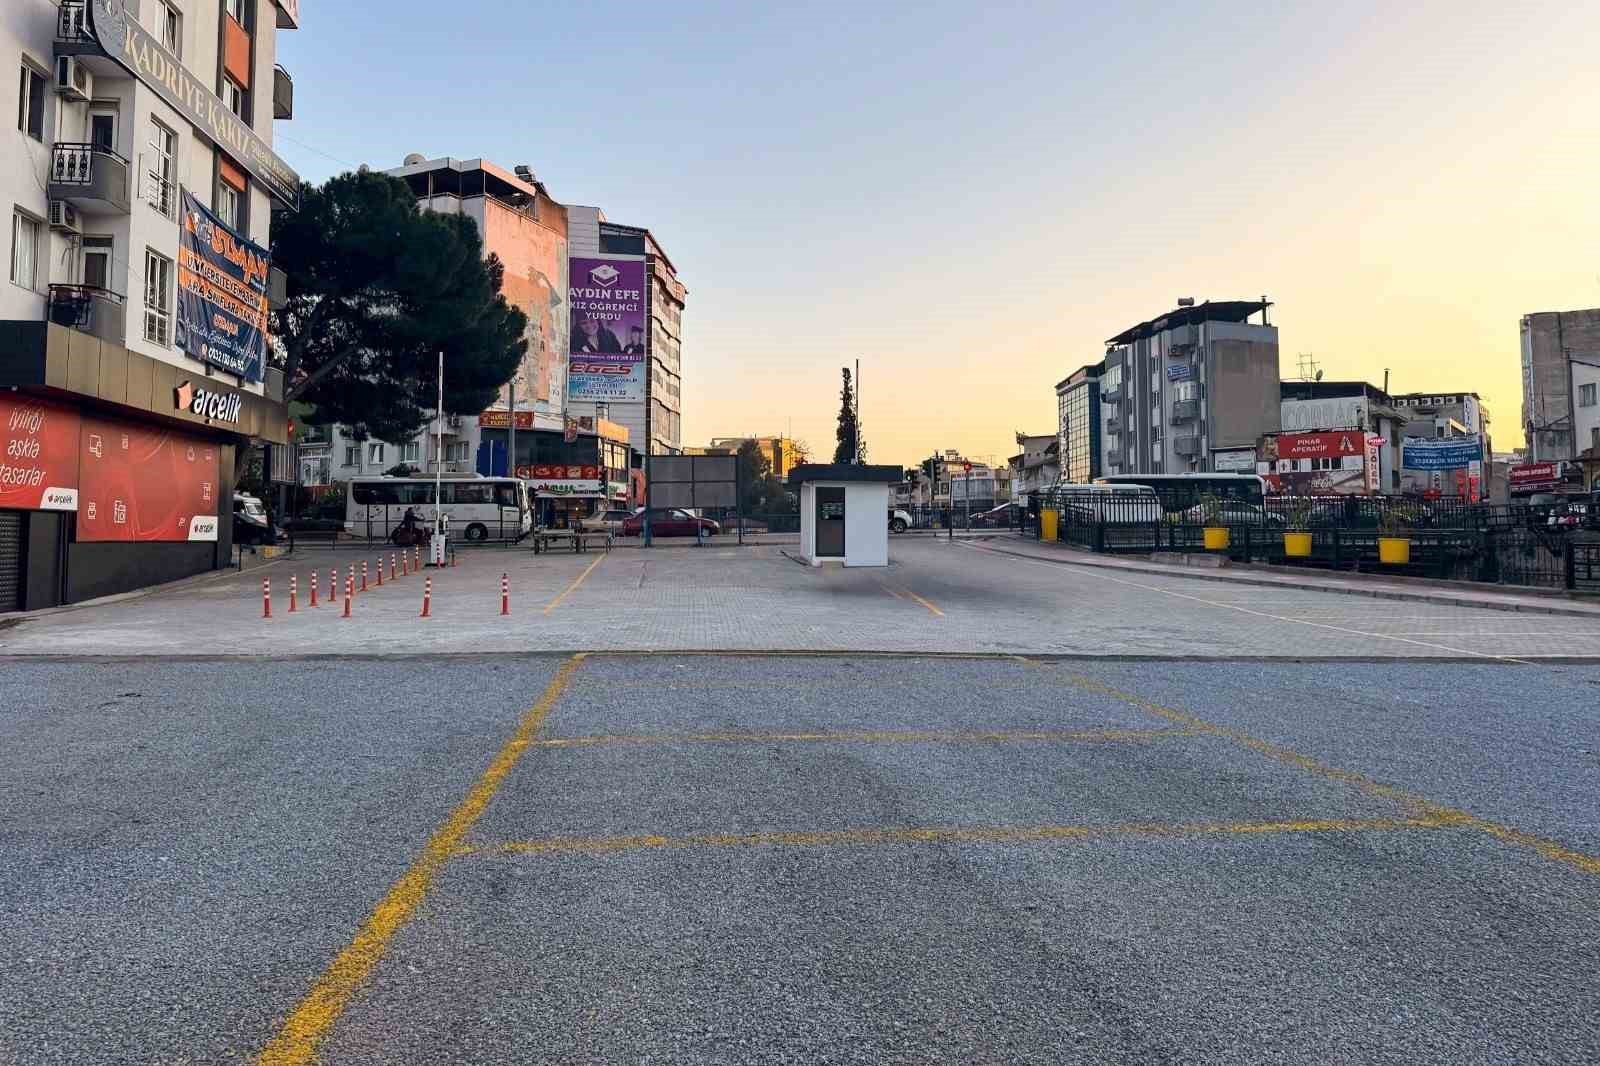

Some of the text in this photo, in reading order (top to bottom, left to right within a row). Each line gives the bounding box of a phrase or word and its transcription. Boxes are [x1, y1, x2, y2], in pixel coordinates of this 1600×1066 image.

[125, 23, 204, 118] KADRİYE
[569, 288, 640, 300] AYDIN EFE
[570, 301, 586, 310] KIZ
[586, 312, 621, 321] YURDU
[569, 363, 632, 375] EGES
[193, 389, 242, 424] arçelik
[7, 438, 40, 459] aşkla
[0, 464, 46, 486] tasarlar
